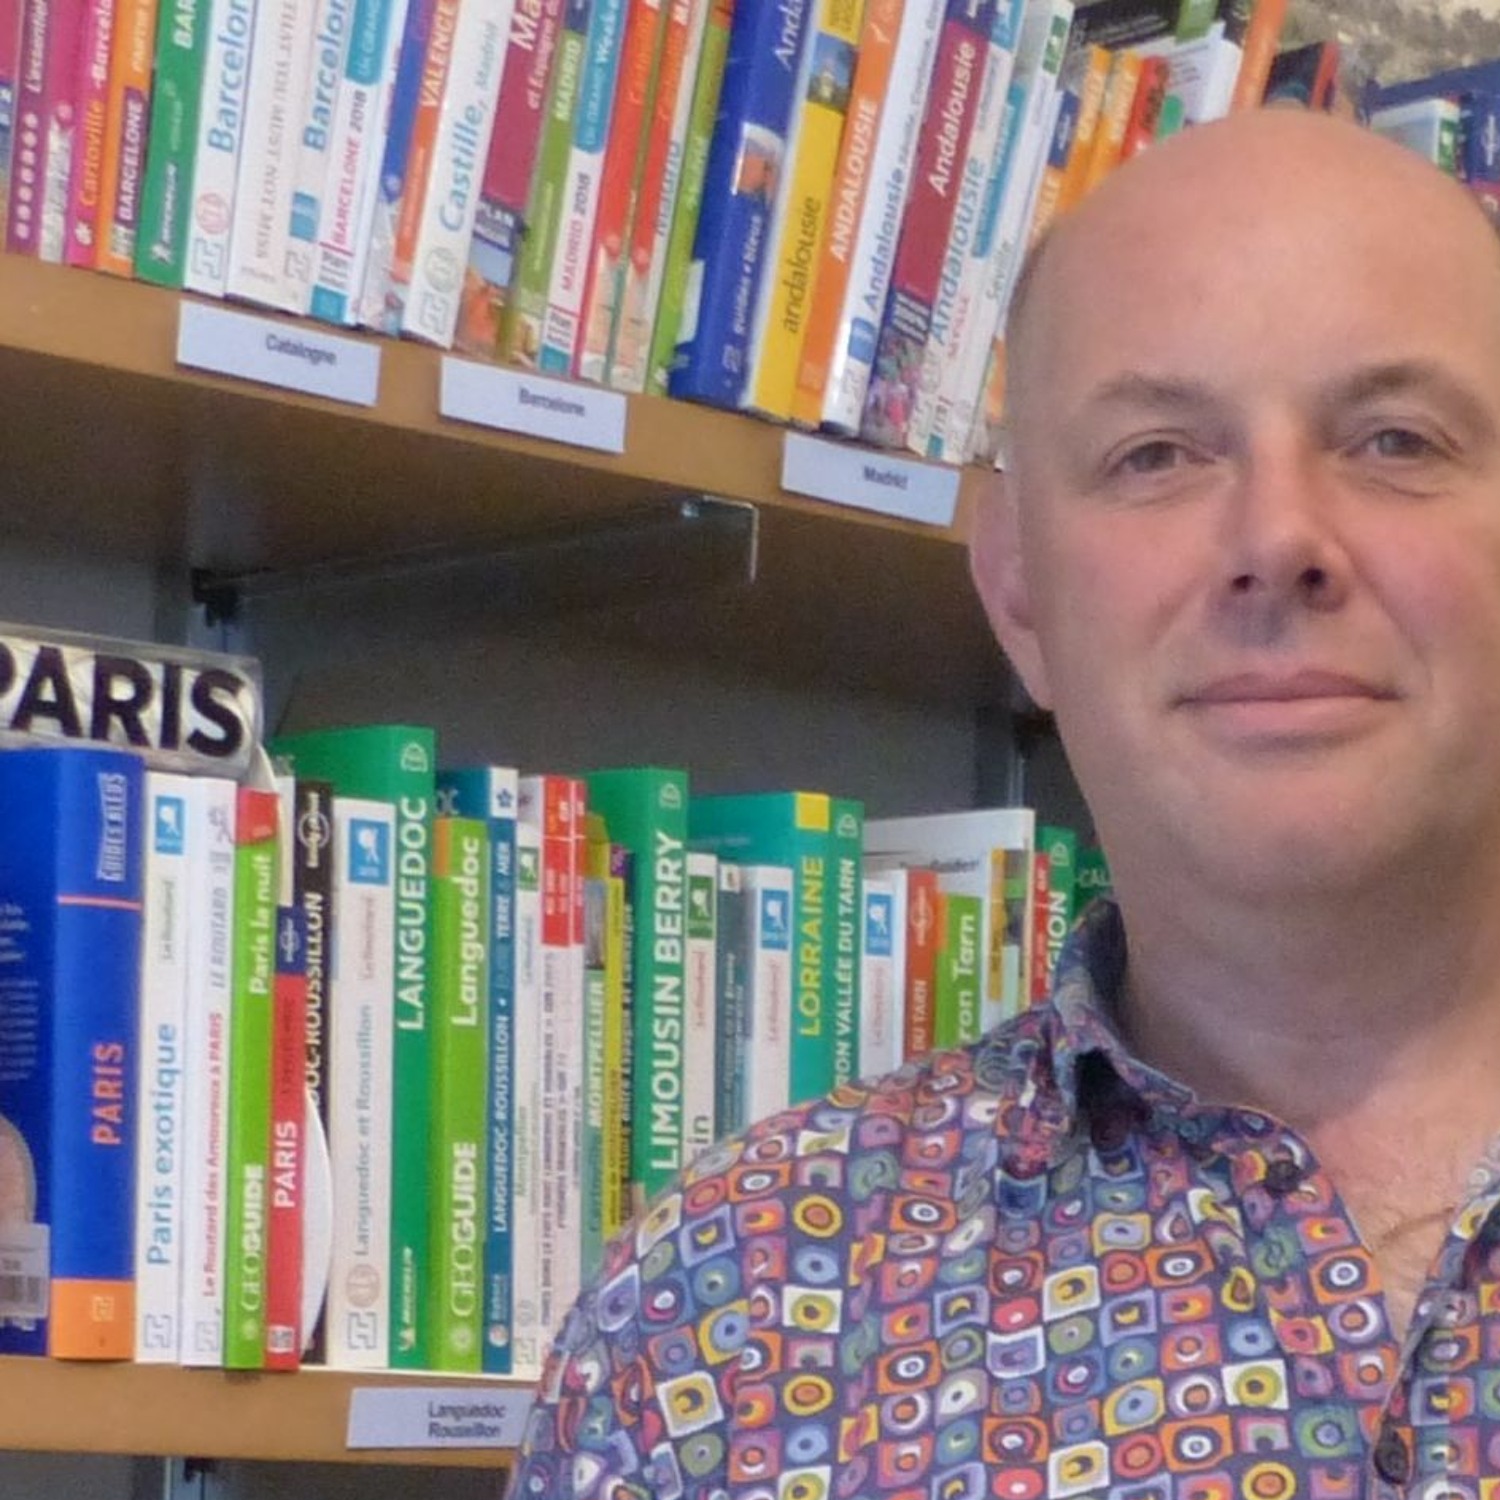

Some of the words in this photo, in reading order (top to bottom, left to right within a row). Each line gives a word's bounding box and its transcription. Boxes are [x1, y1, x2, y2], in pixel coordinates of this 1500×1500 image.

[556, 39, 583, 122] MADRID
[928, 39, 977, 199] Andalousie
[118, 99, 145, 222] BARCELONE
[332, 133, 363, 246] BARCELONE
[828, 98, 879, 262] ANDALOUSIE
[562, 215, 584, 292] MADRID
[783, 196, 821, 336] andalousie
[864, 168, 905, 313] Andalousie
[932, 156, 986, 347] Andalousie
[251, 854, 272, 902] nuit
[498, 841, 513, 876] MER
[654, 830, 685, 963] BERRY
[836, 858, 856, 914] TARN
[211, 887, 229, 966] ROUTARD
[250, 908, 270, 928] la
[399, 796, 429, 1031] LANGUEDOC
[452, 836, 484, 1026] Languedoc
[497, 892, 512, 940] TERRE
[797, 857, 824, 1036] LORRAINE
[835, 920, 853, 952] DU
[952, 914, 975, 982] Tarn
[249, 935, 271, 995] Paris
[834, 956, 854, 1038] VALLÉE
[912, 979, 928, 1022] TARN
[209, 1012, 223, 1062] PARIS
[356, 1005, 374, 1110] Roussillon
[588, 980, 605, 1128] MONTPELLIER
[652, 976, 682, 1170] LIMOUSIN
[912, 1025, 928, 1051] DU
[92, 1042, 125, 1145] PARIS
[154, 1024, 182, 1174] exotique
[206, 1080, 222, 1166] Amoureux
[356, 1116, 371, 1137] et
[493, 1015, 510, 1234] LANGUEDOC-ROUSSILLON
[205, 1171, 220, 1201] des
[274, 1120, 298, 1208] PARIS
[515, 1105, 531, 1197] Montpellier
[147, 1186, 175, 1266] Paris
[203, 1206, 220, 1274] Routard
[355, 1142, 375, 1257] Languedoc
[203, 1278, 218, 1297] Le
[400, 1245, 415, 1325] MICHELIN
[428, 1401, 506, 1422] Languedoc
[428, 1422, 500, 1440] Roussillon
